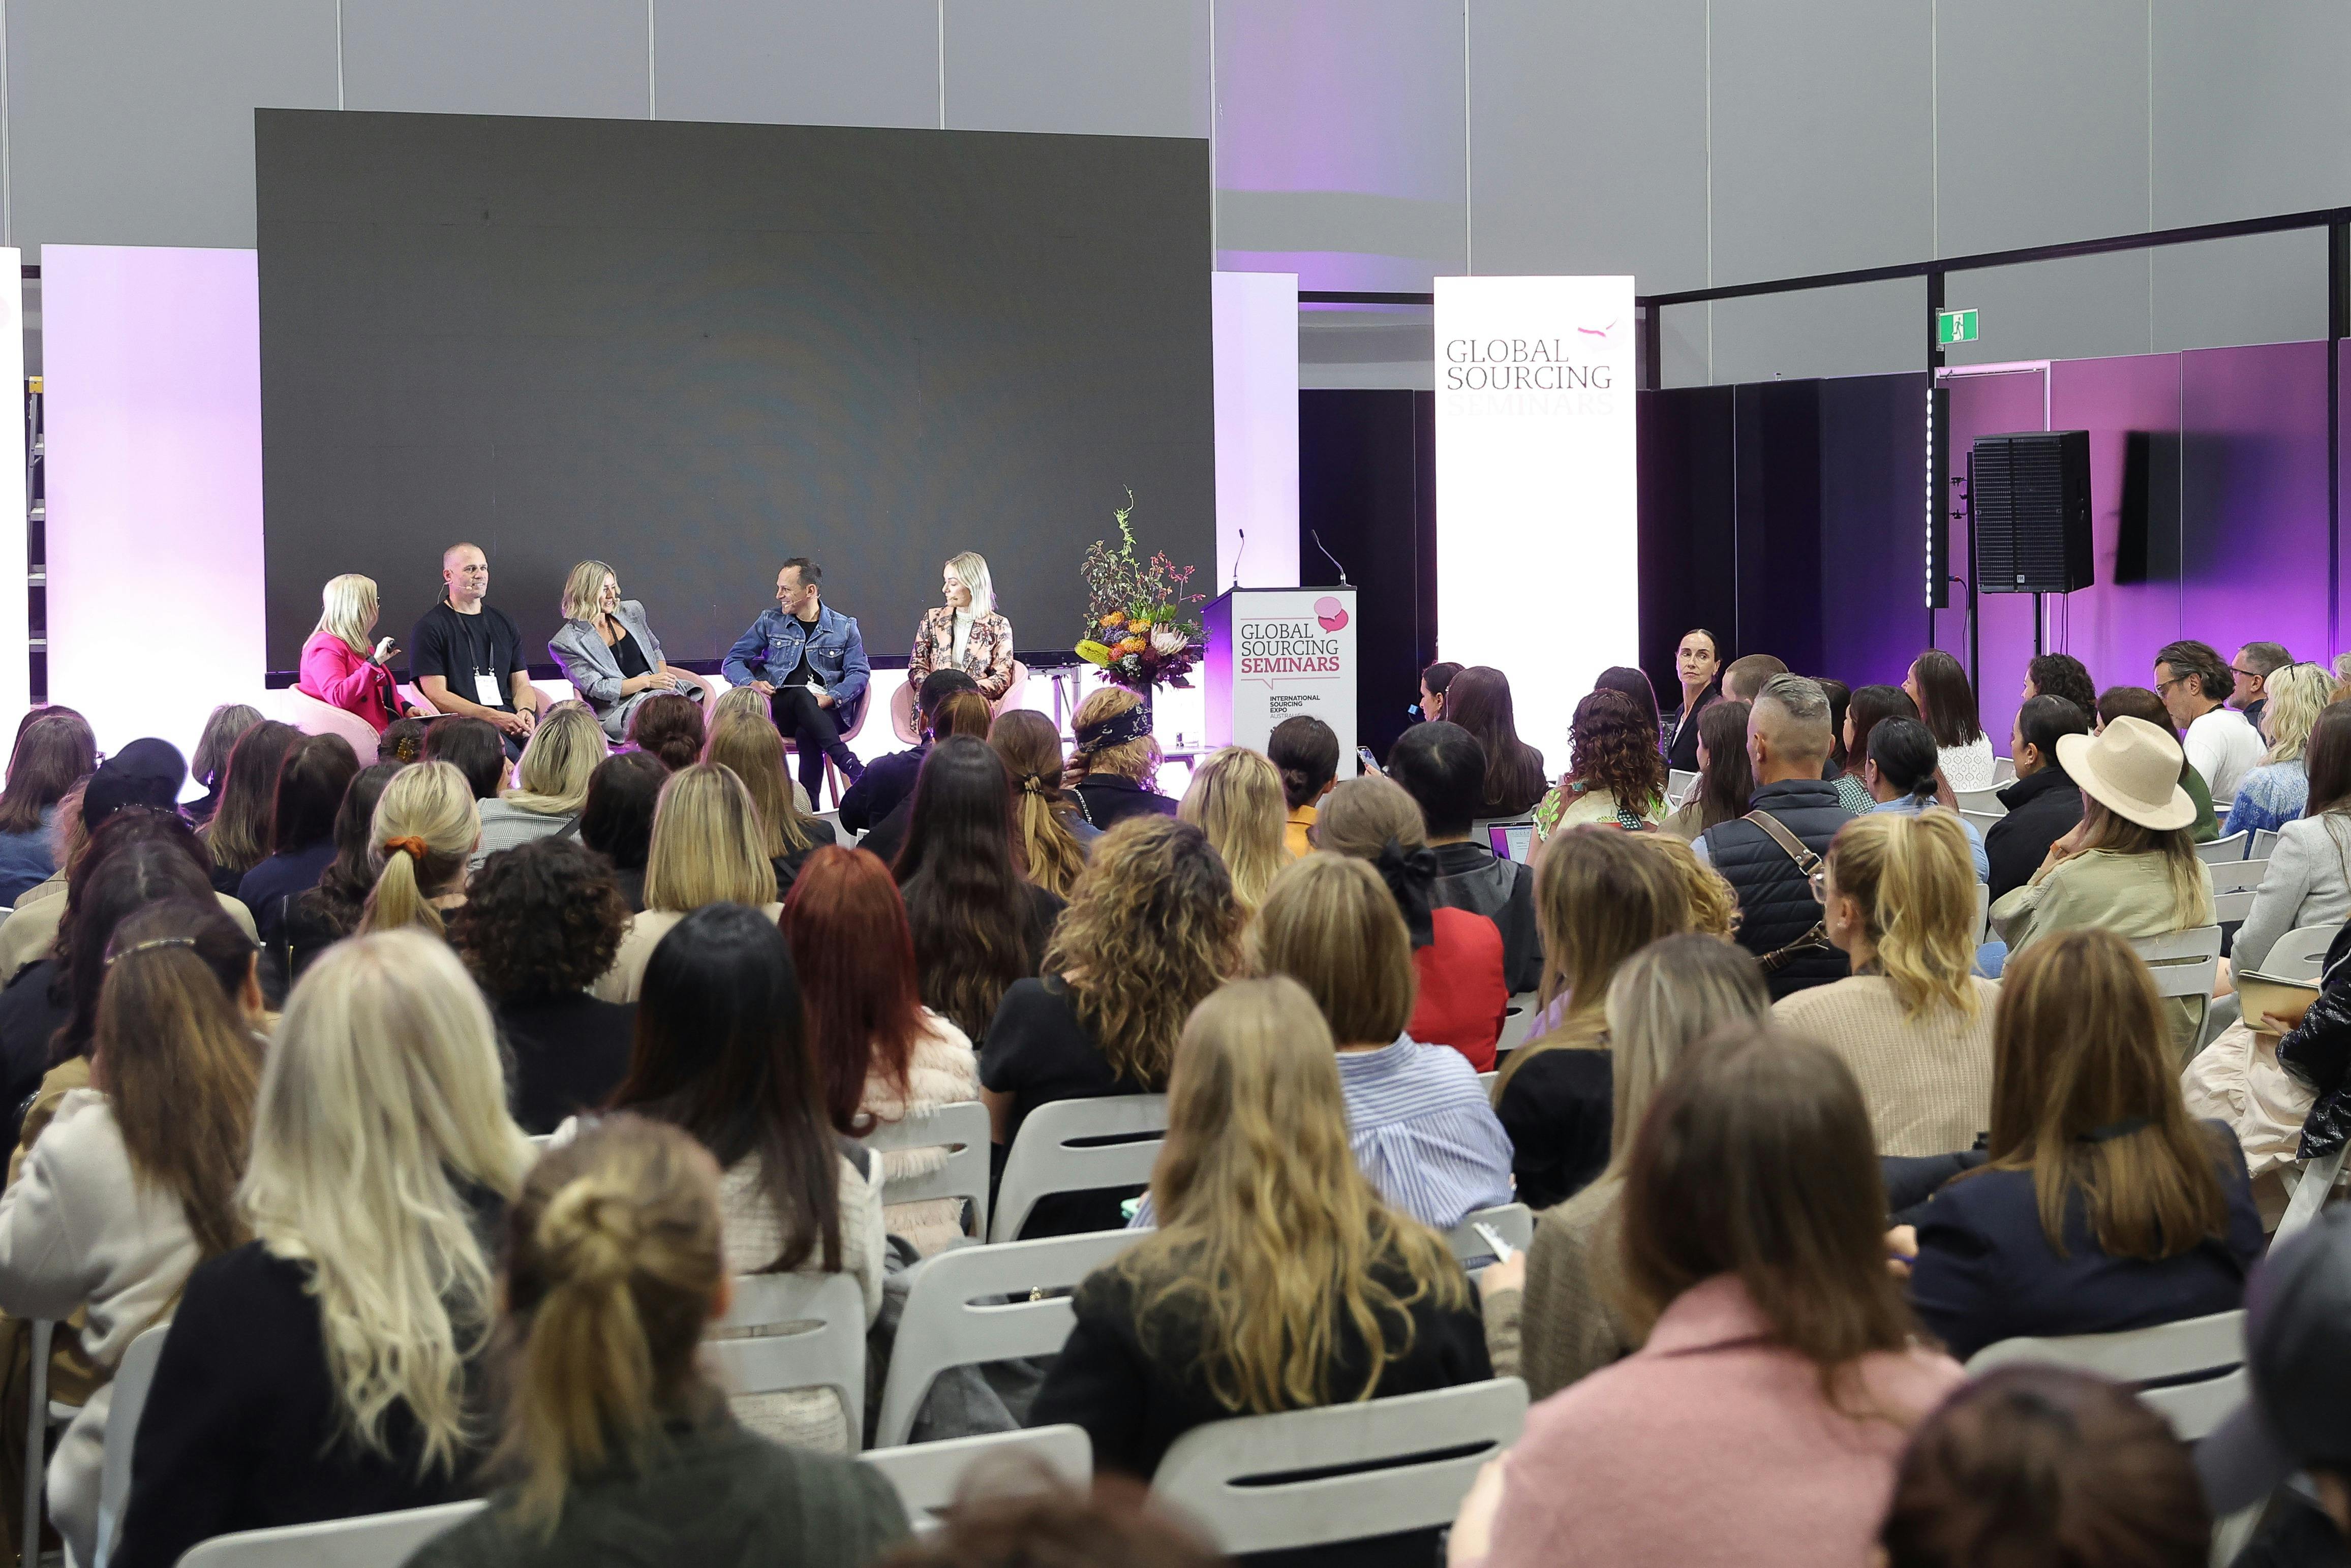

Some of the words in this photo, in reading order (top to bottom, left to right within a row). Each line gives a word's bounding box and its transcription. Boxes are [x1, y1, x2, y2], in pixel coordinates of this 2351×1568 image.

[1447, 339, 1569, 363] GLOBAL
[1447, 366, 1612, 390] SOURCING
[1448, 394, 1613, 416] SEMINARS
[1241, 623, 1314, 639] GLOBAL
[1241, 640, 1339, 656] SOURCING
[1241, 657, 1340, 673] SEMINARS
